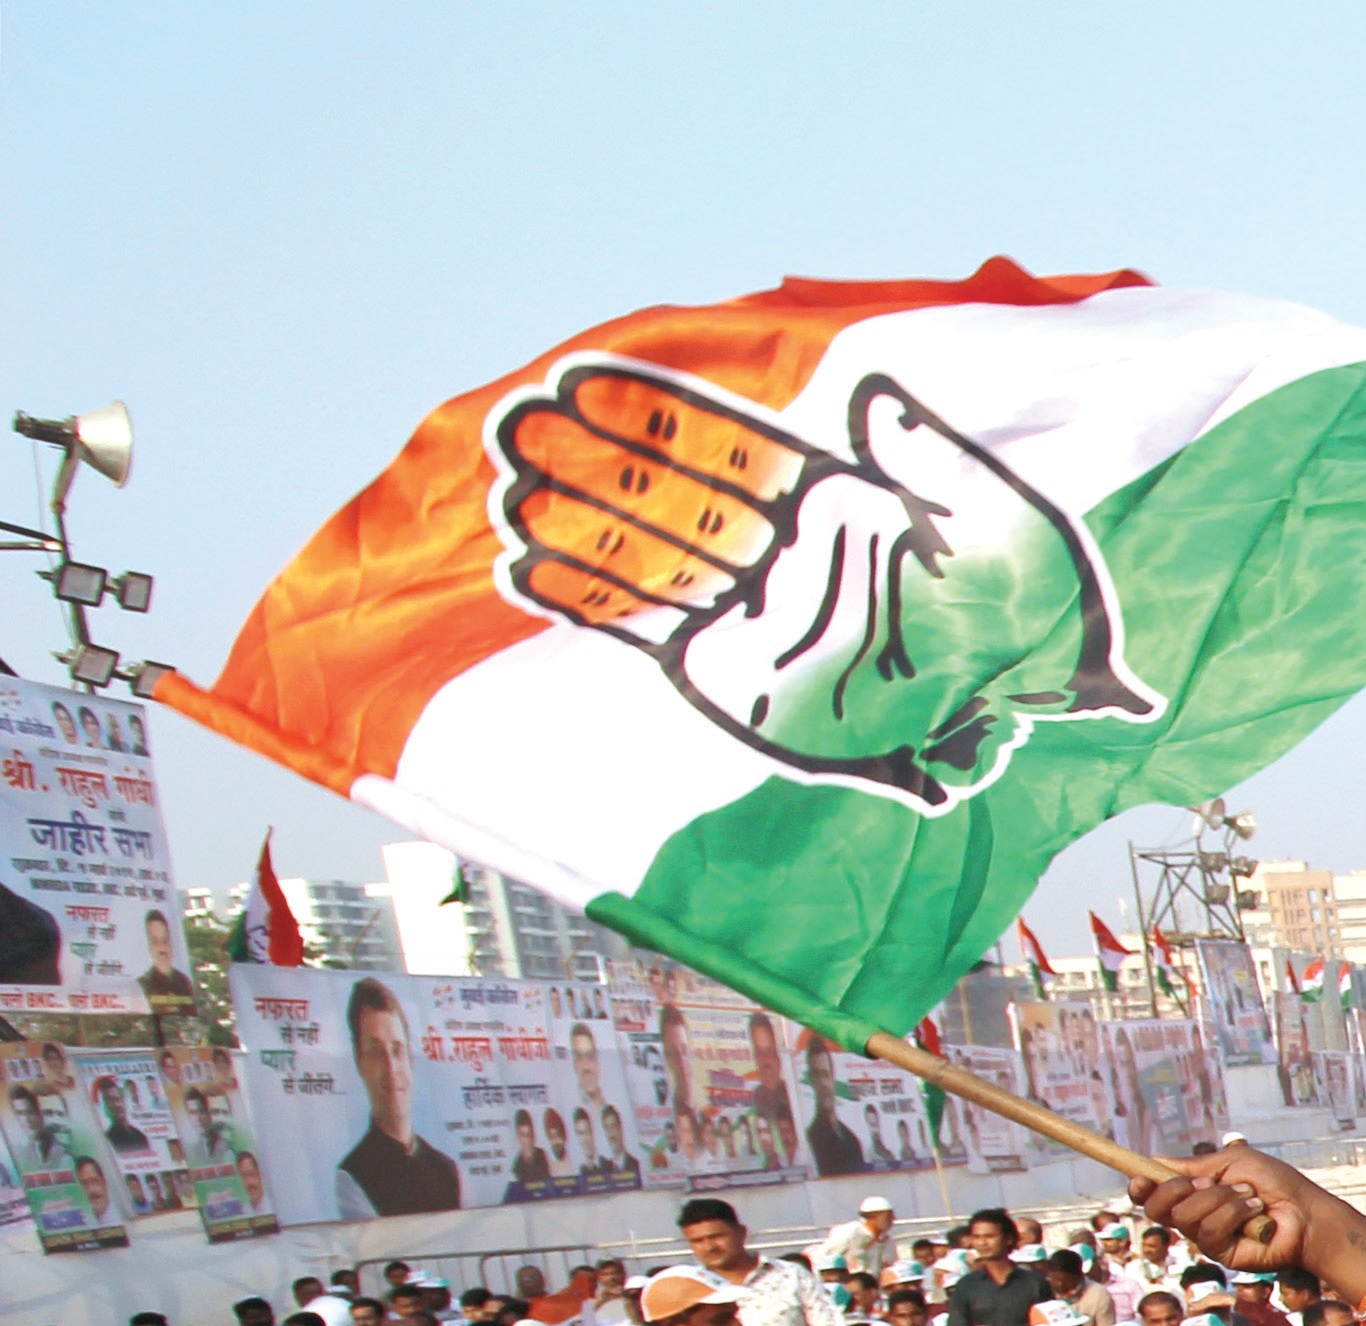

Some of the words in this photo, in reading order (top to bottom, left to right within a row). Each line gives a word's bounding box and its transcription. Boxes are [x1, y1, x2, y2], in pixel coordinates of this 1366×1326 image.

[55, 766, 109, 809] राहुल
[112, 766, 156, 807] गांधी
[28, 810, 109, 856] जाहीर
[111, 827, 153, 860] सभा
[65, 905, 110, 923] नफरत
[254, 997, 309, 1020] नफरत
[280, 1022, 294, 1044] से
[260, 1049, 296, 1072] प्यार
[282, 1074, 295, 1095] से
